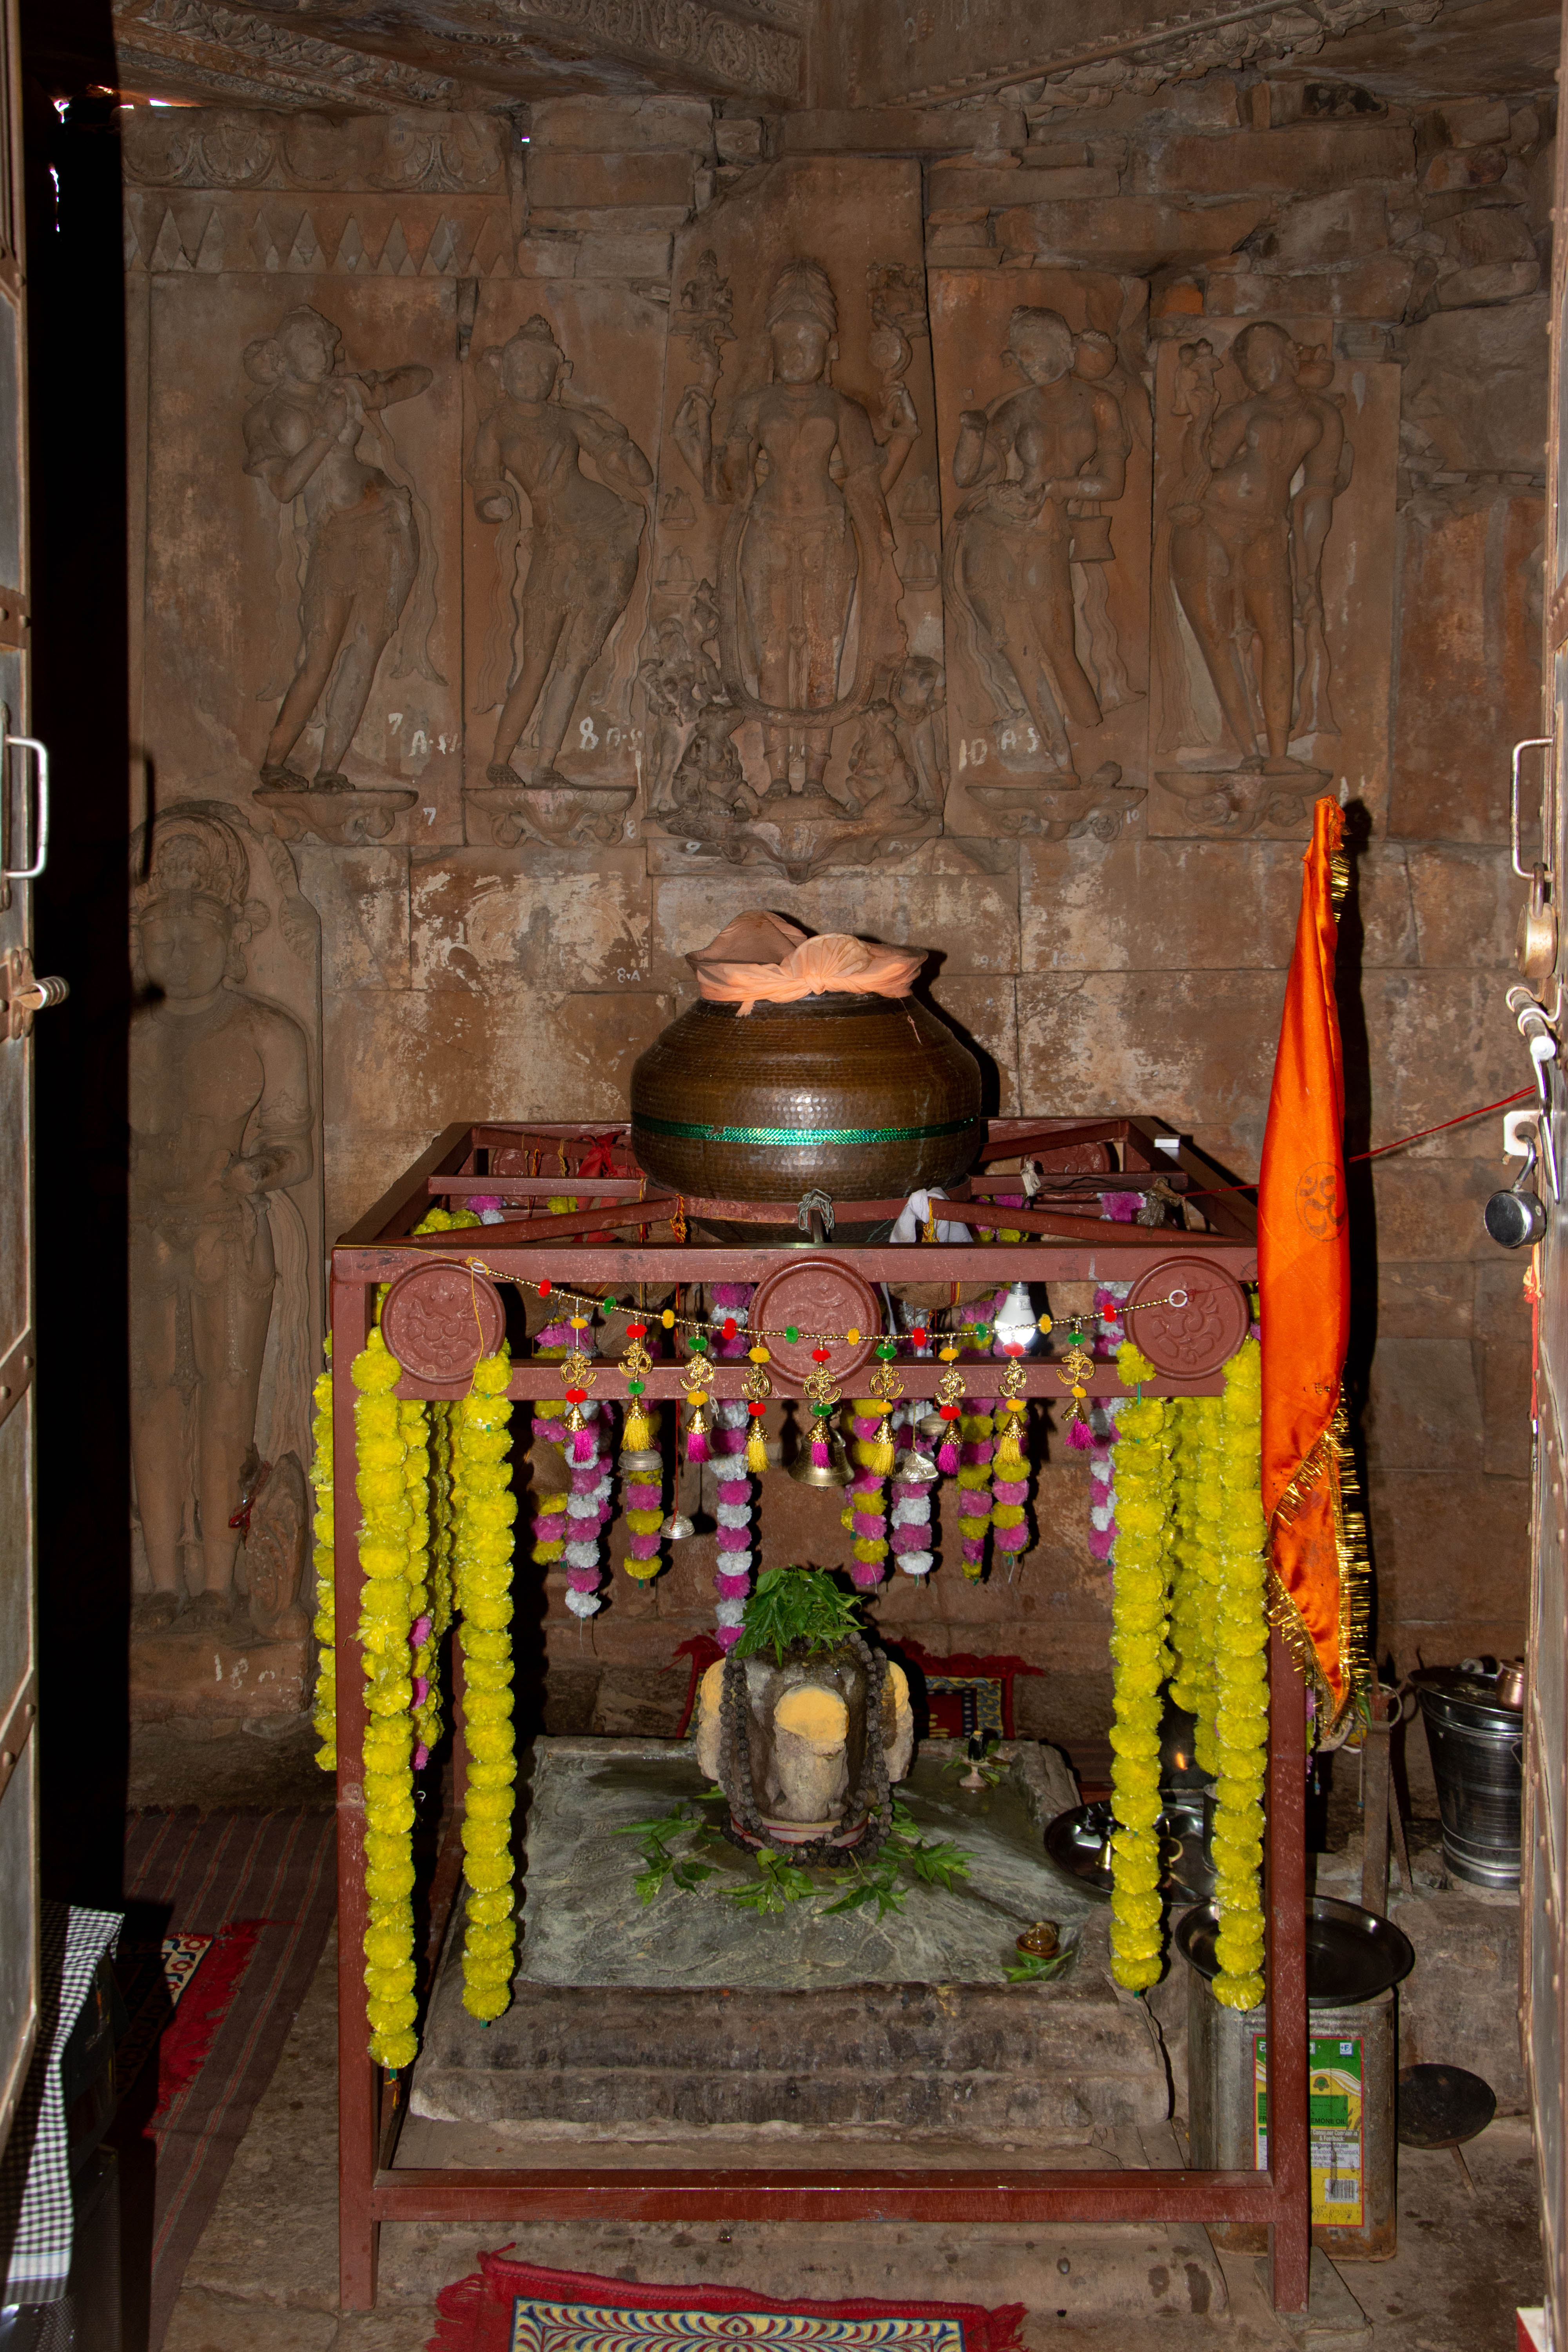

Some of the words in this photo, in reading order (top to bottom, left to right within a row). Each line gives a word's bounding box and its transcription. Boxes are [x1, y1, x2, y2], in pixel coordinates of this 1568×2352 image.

[388, 713, 403, 735] 7
[579, 716, 599, 750] 8
[959, 739, 988, 771] 10
[423, 807, 436, 826] 7
